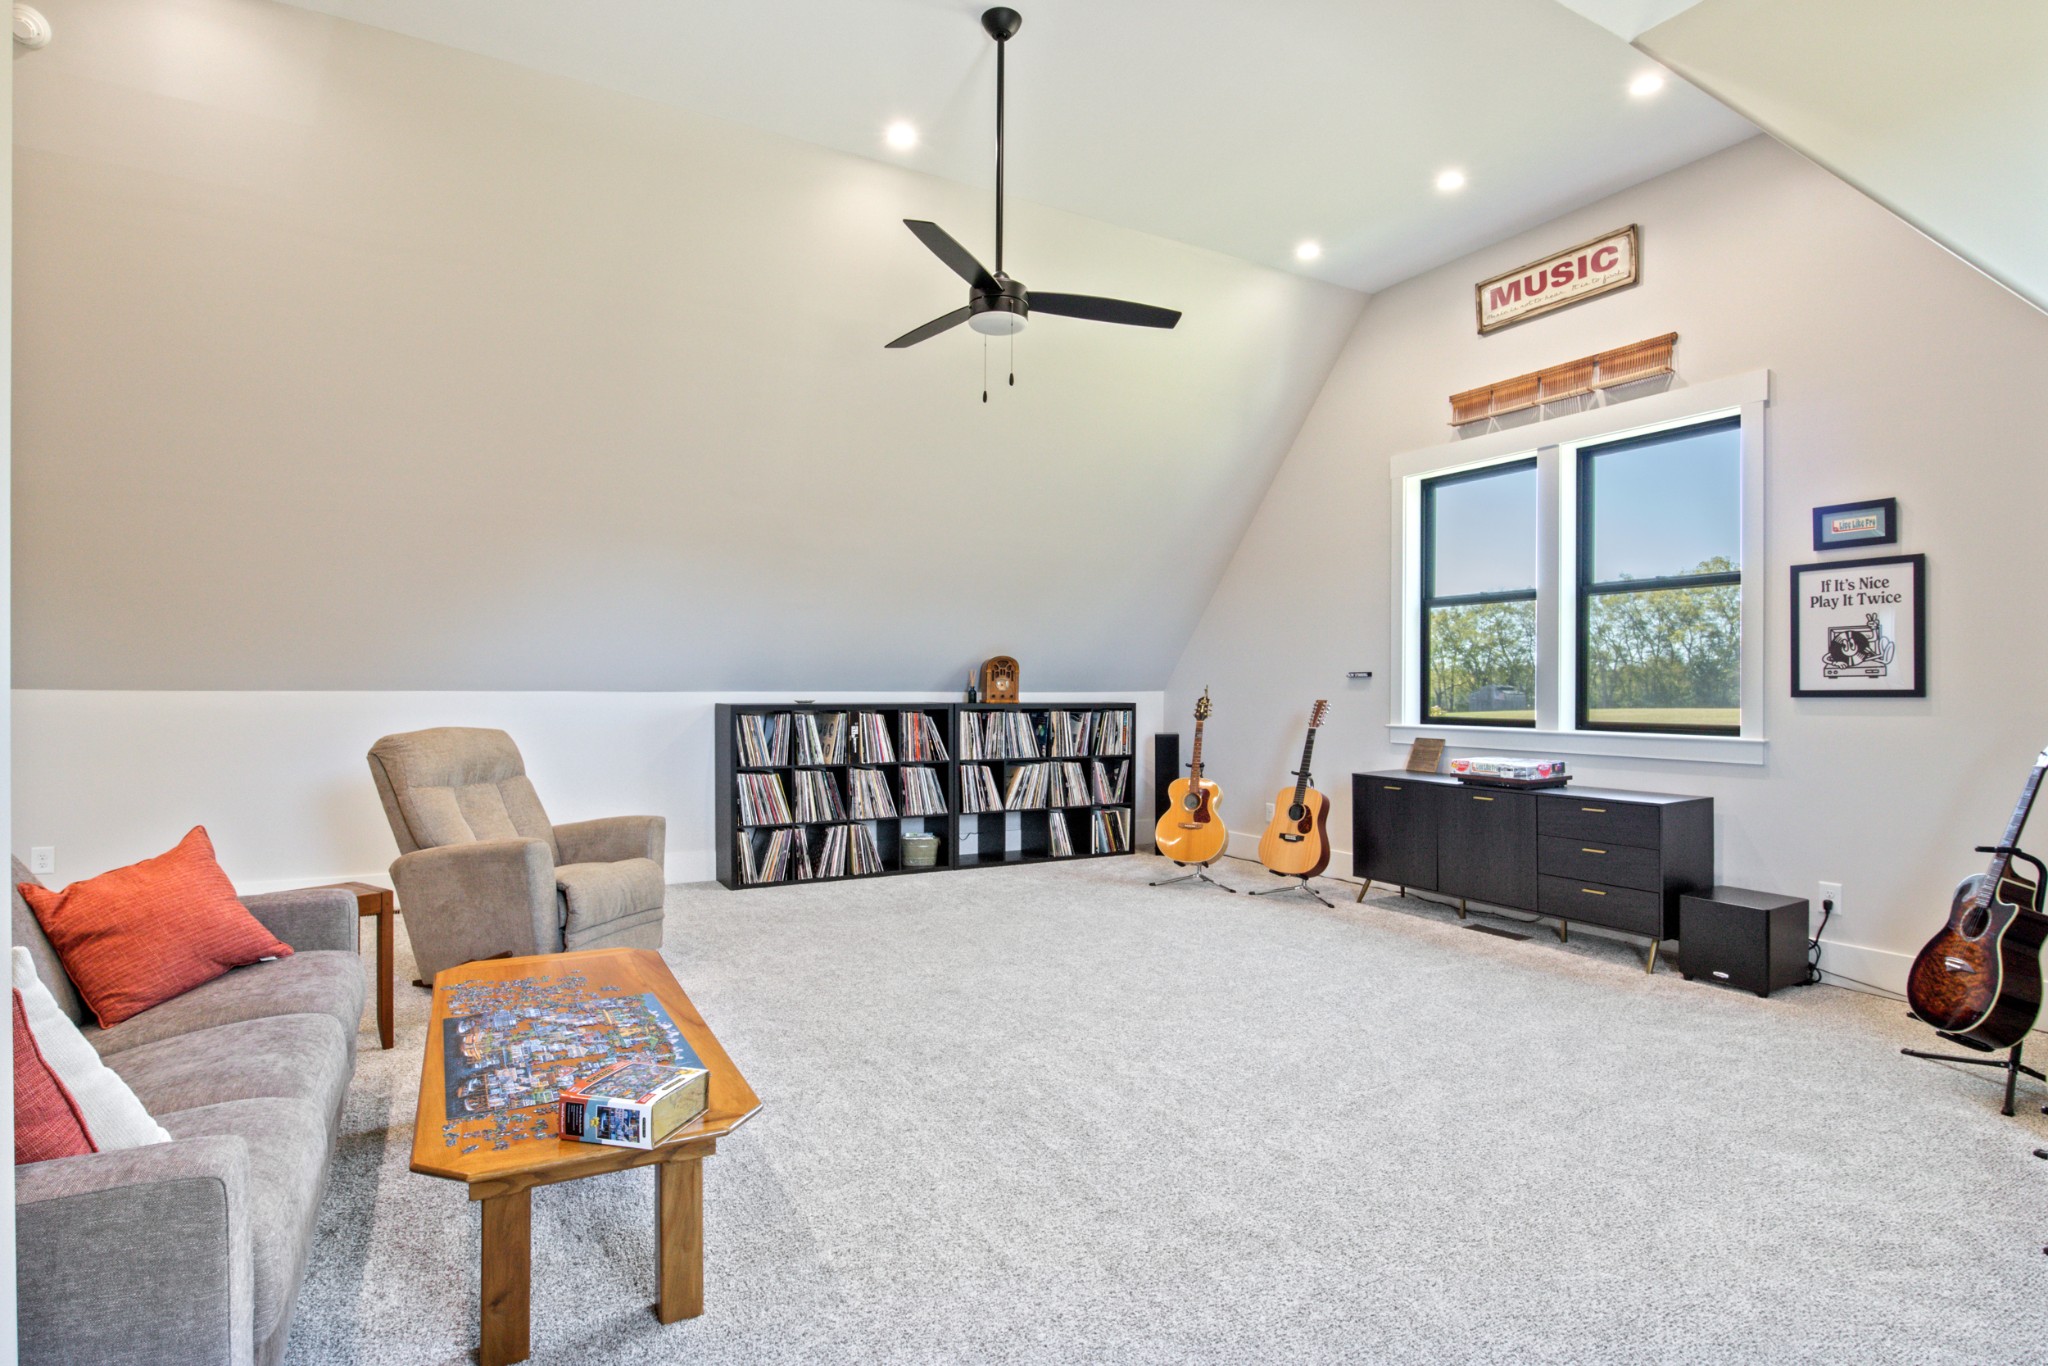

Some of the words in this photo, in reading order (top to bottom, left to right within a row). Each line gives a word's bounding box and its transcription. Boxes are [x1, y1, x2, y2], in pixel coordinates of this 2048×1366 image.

[1490, 246, 1618, 311] MUSIC
[1821, 579, 1832, 593] If
[1834, 578, 1855, 592] It's
[1859, 576, 1890, 590] Nice
[1810, 595, 1839, 610] Play
[1843, 593, 1854, 606] It
[1857, 591, 1902, 605] Twice
